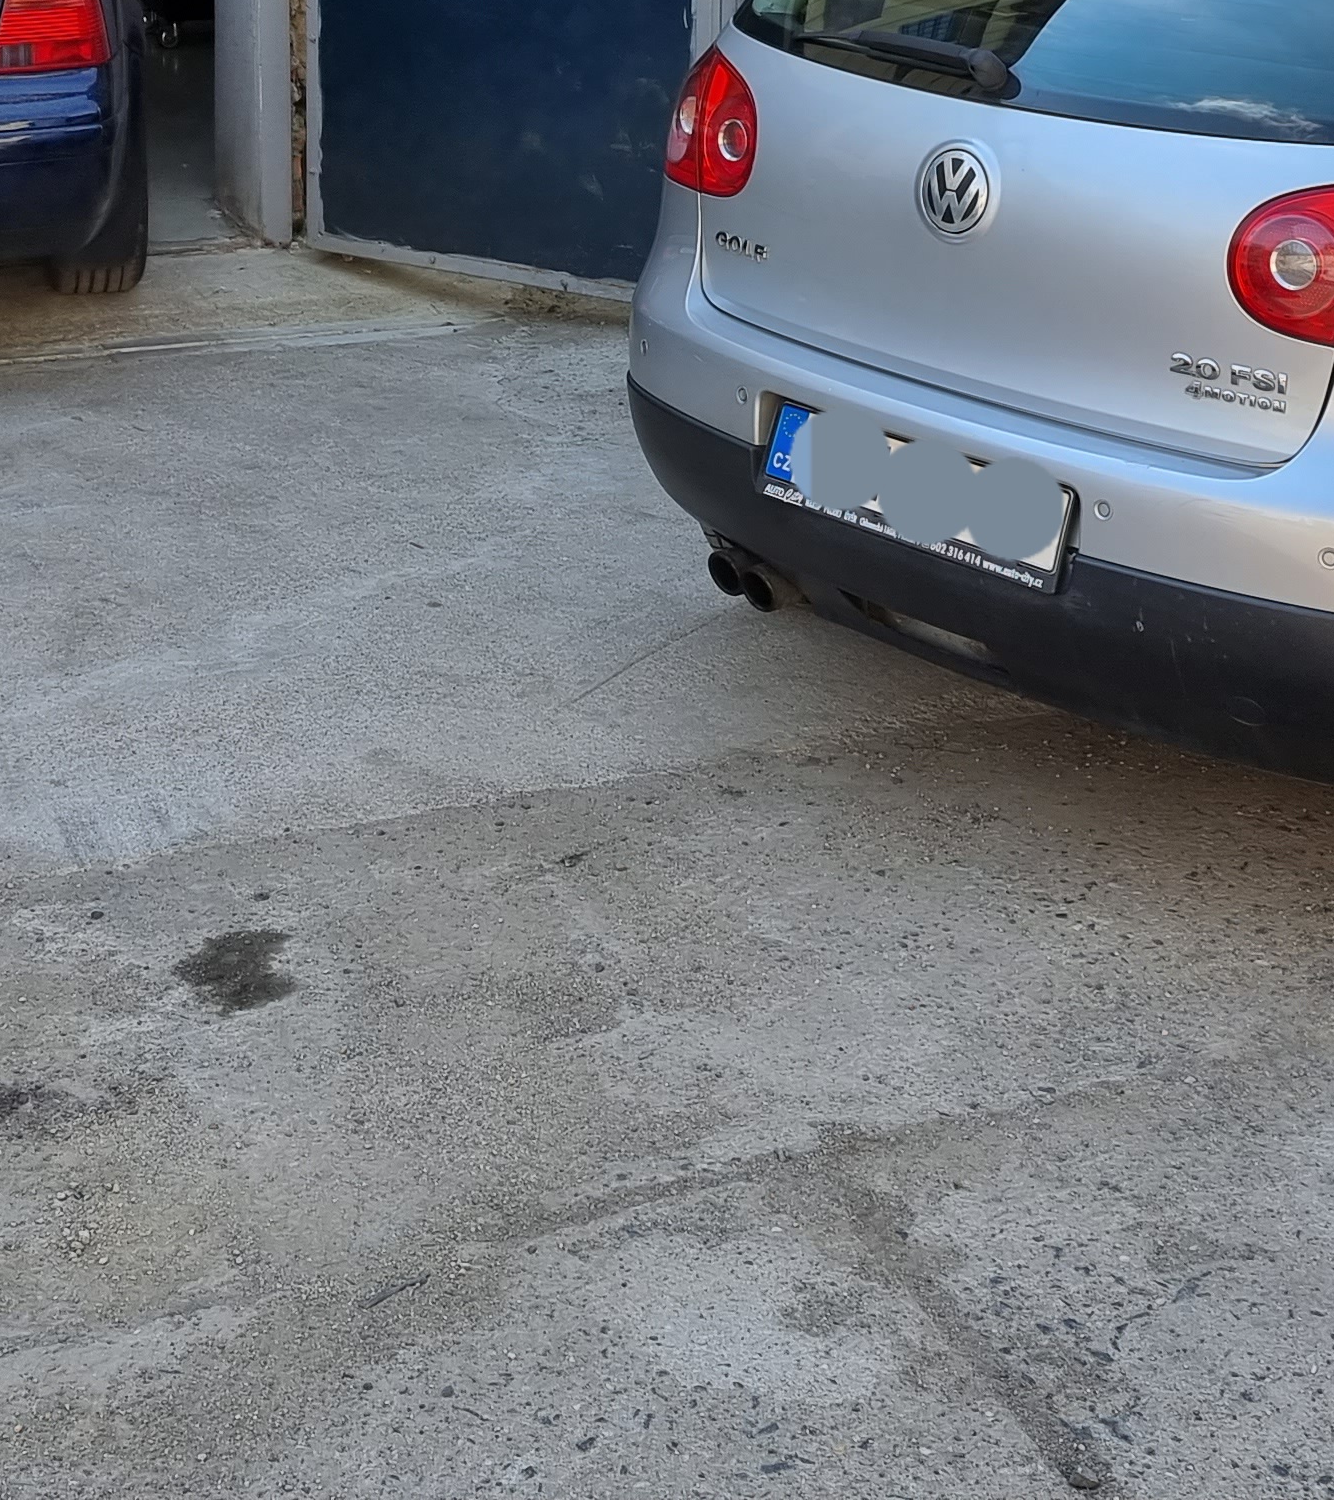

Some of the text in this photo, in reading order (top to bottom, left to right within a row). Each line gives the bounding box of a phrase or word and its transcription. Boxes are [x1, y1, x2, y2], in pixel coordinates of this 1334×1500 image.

[715, 231, 769, 264] GOLF
[1230, 364, 1288, 395] FSI
[1185, 381, 1286, 414] 4MOTION
[773, 452, 792, 472] CZ
[946, 545, 964, 561] 316
[964, 551, 982, 567] 414
